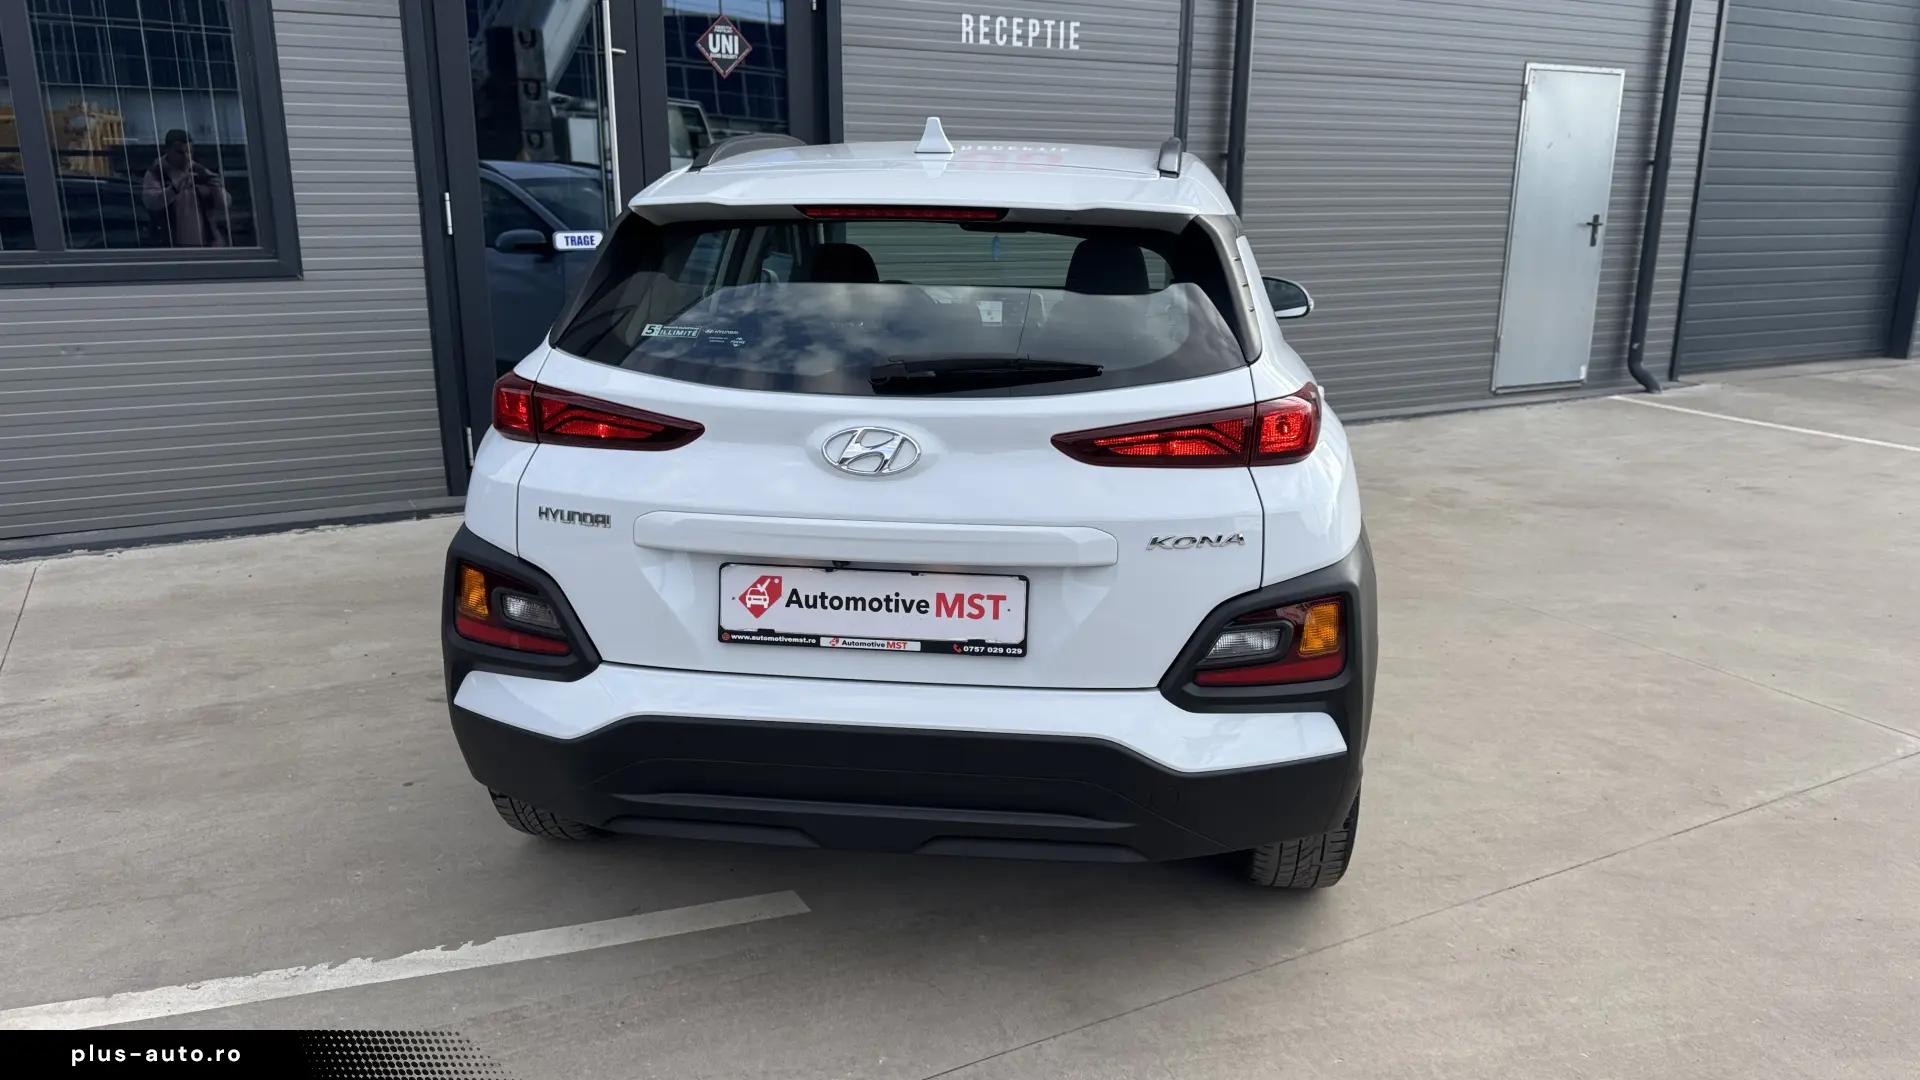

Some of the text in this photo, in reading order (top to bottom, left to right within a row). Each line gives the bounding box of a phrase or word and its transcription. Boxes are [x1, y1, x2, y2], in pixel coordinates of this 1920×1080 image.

[961, 13, 1081, 50] RECEPTIE
[708, 33, 739, 55] UNI
[564, 235, 596, 247] TRAGE
[645, 325, 656, 335] 5
[659, 329, 699, 337] ILLIMITÉ
[538, 506, 612, 528] HYUNDAI
[1145, 533, 1246, 550] KONA
[785, 588, 1007, 620] Automotive MST
[730, 633, 817, 644] www.automotivemst.ro
[841, 639, 908, 650] Automotive MST
[963, 645, 1023, 655] 0757 029 029
